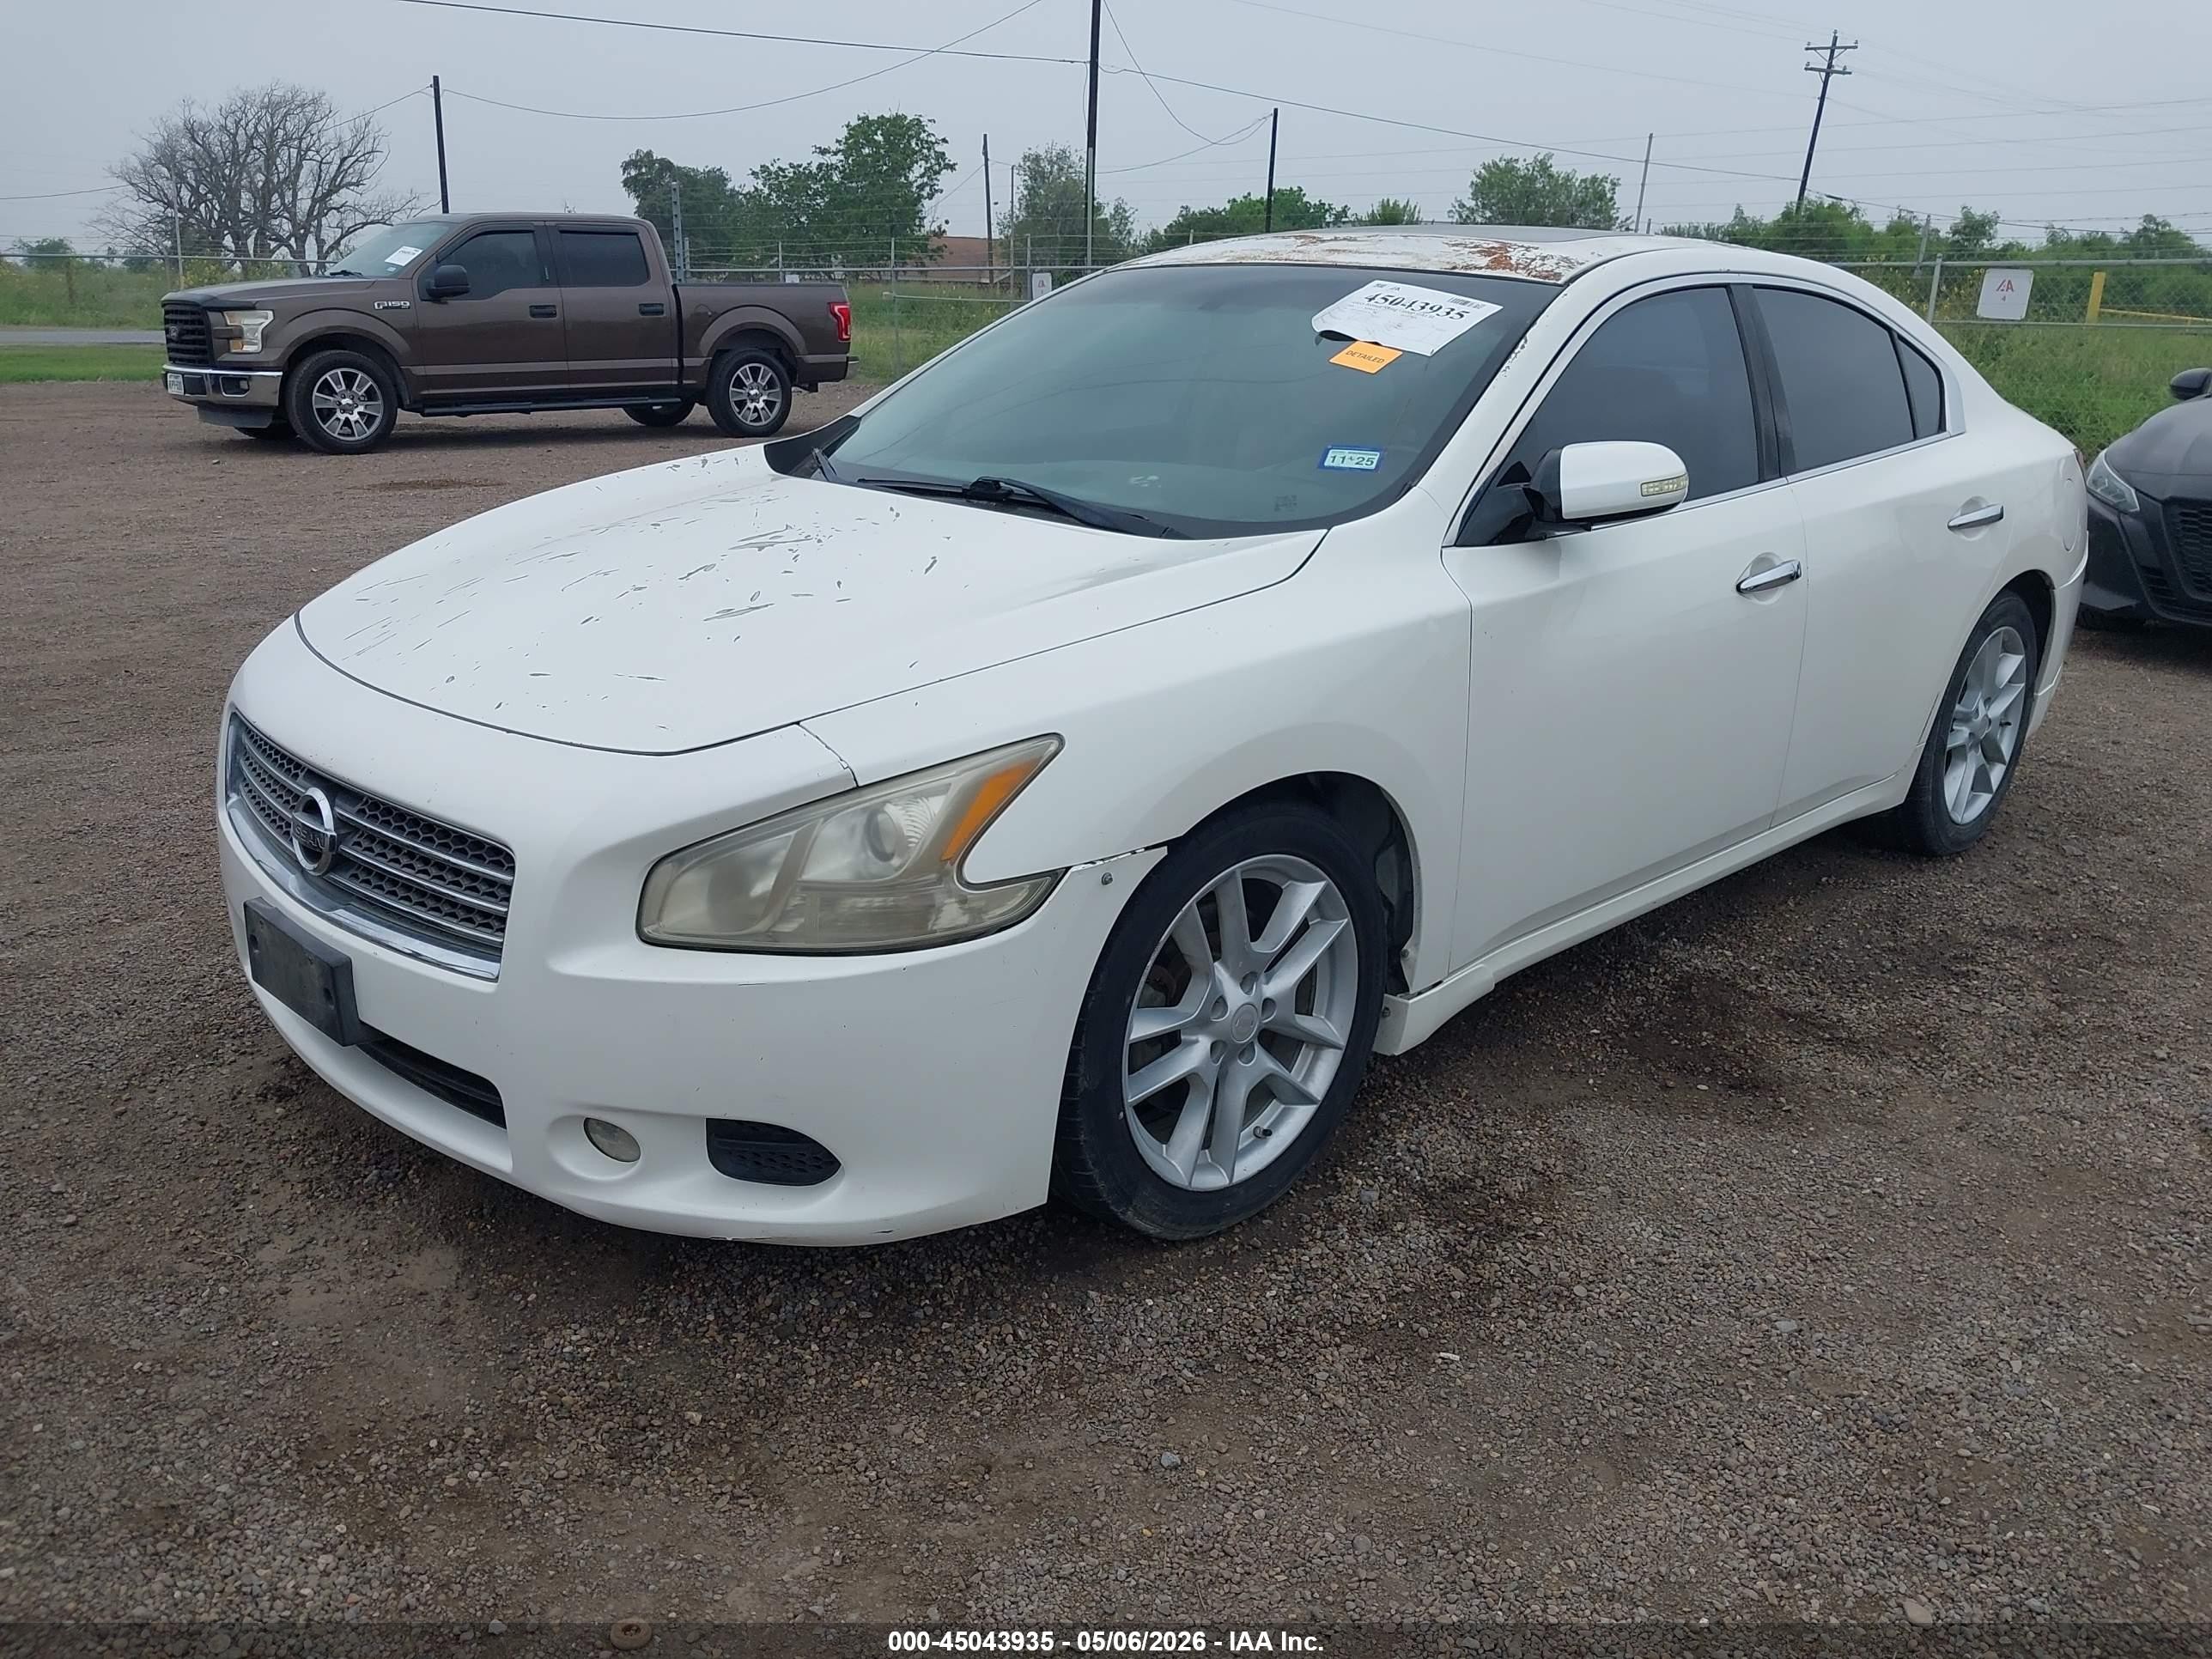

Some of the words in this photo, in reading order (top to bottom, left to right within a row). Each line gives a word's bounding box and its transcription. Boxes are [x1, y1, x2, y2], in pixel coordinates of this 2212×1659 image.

[1346, 349, 1386, 364] DETAILED
[1330, 454, 1346, 465] 11
[1354, 456, 1376, 466] 25
